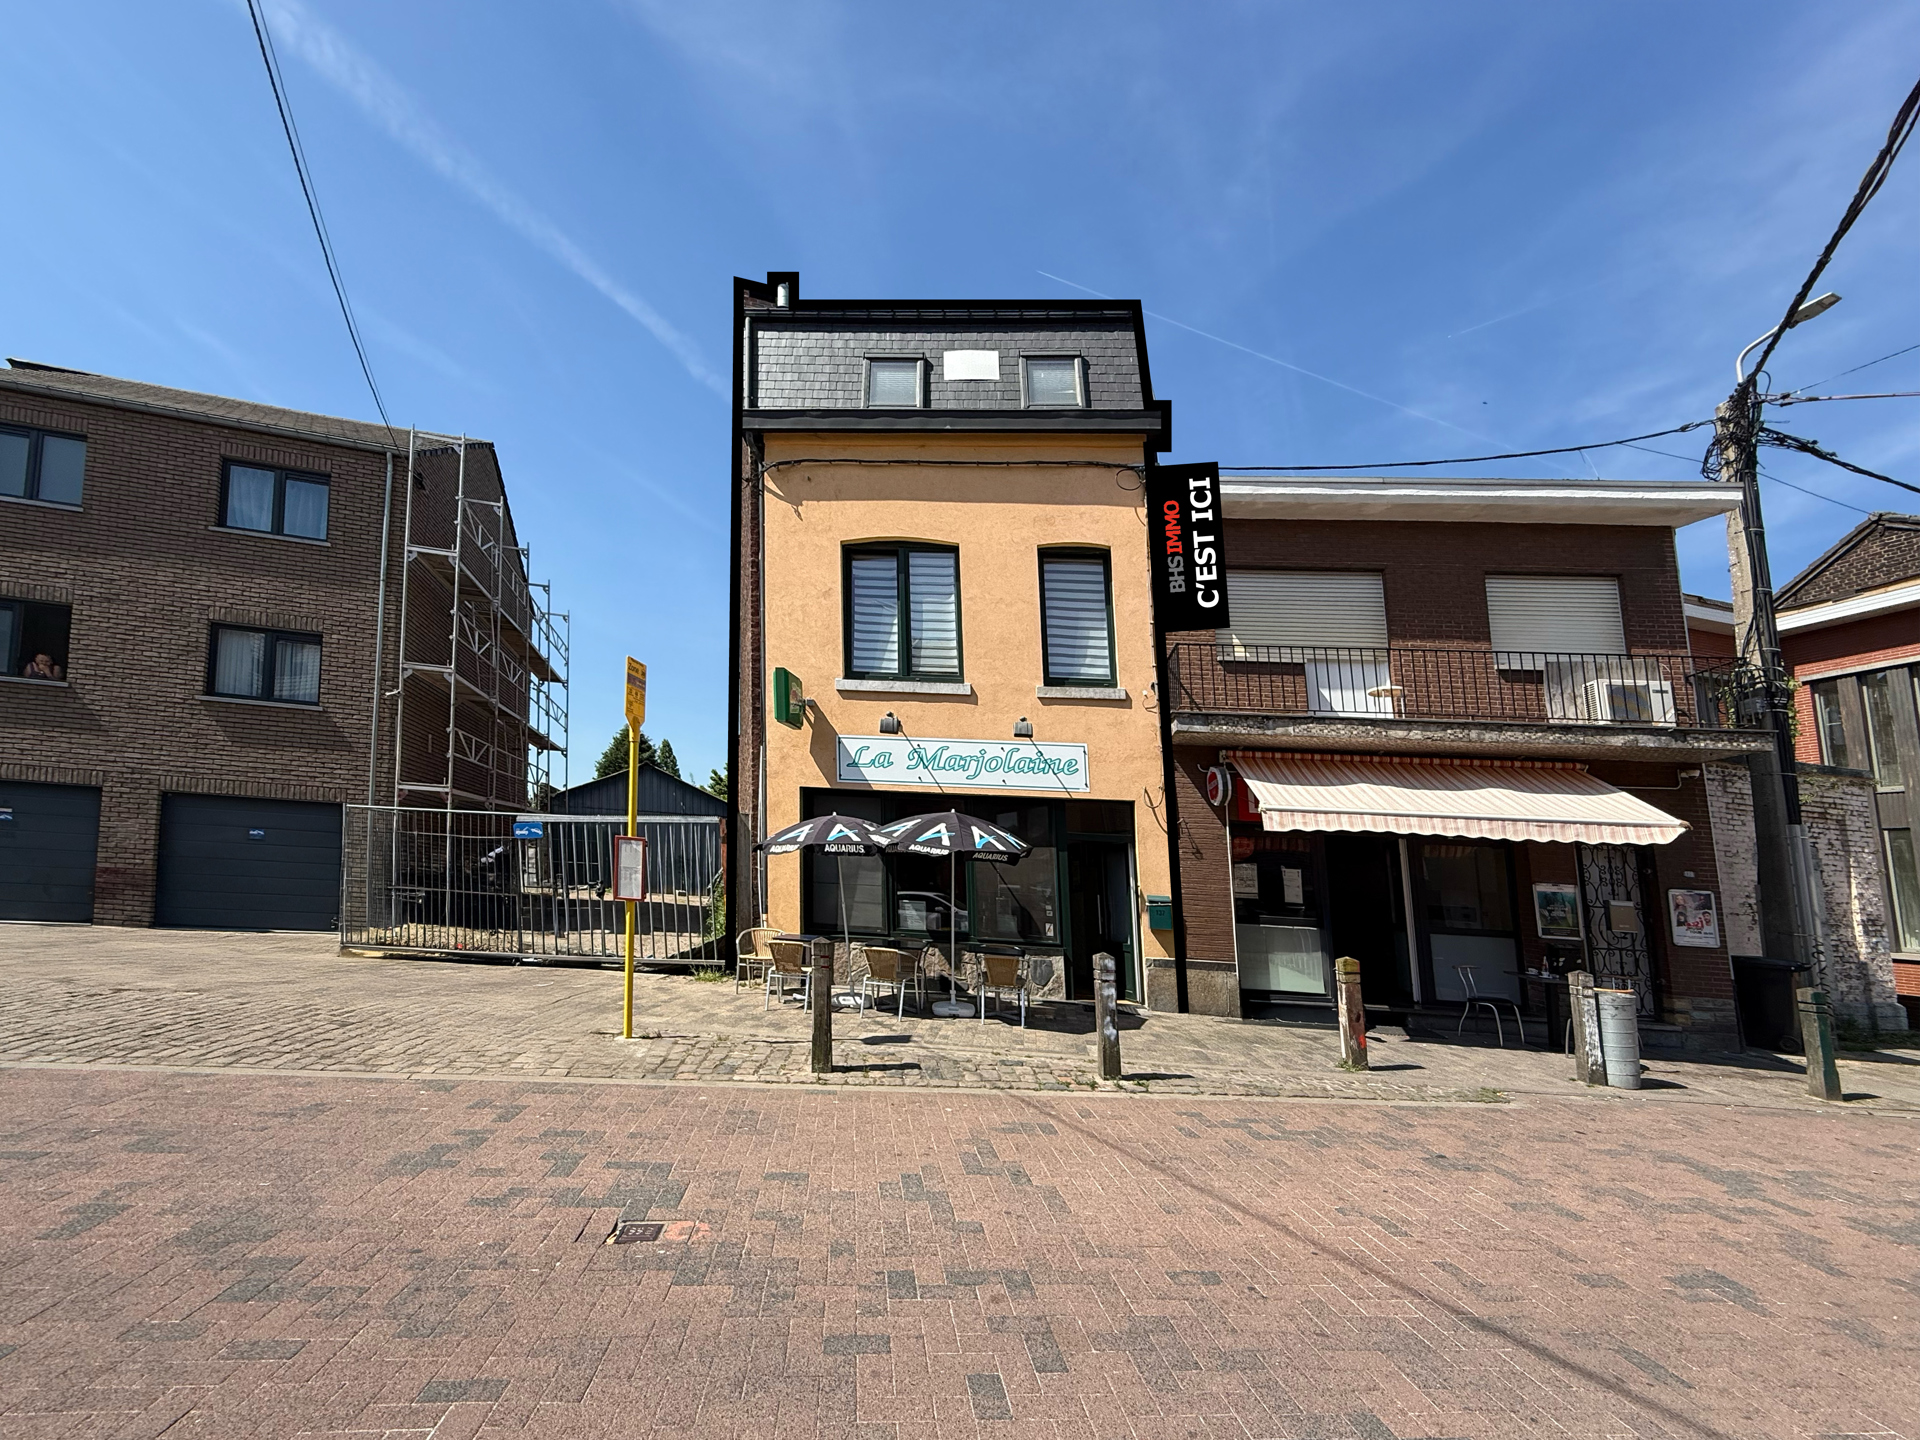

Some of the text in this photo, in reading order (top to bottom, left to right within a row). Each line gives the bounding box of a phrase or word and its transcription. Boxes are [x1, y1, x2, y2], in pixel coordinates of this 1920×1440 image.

[846, 745, 1079, 780] La Marjolaine
[824, 844, 865, 853] AQUARIUS
[908, 844, 950, 855] AQUARIUS
[972, 852, 1008, 861] AQUARIUS
